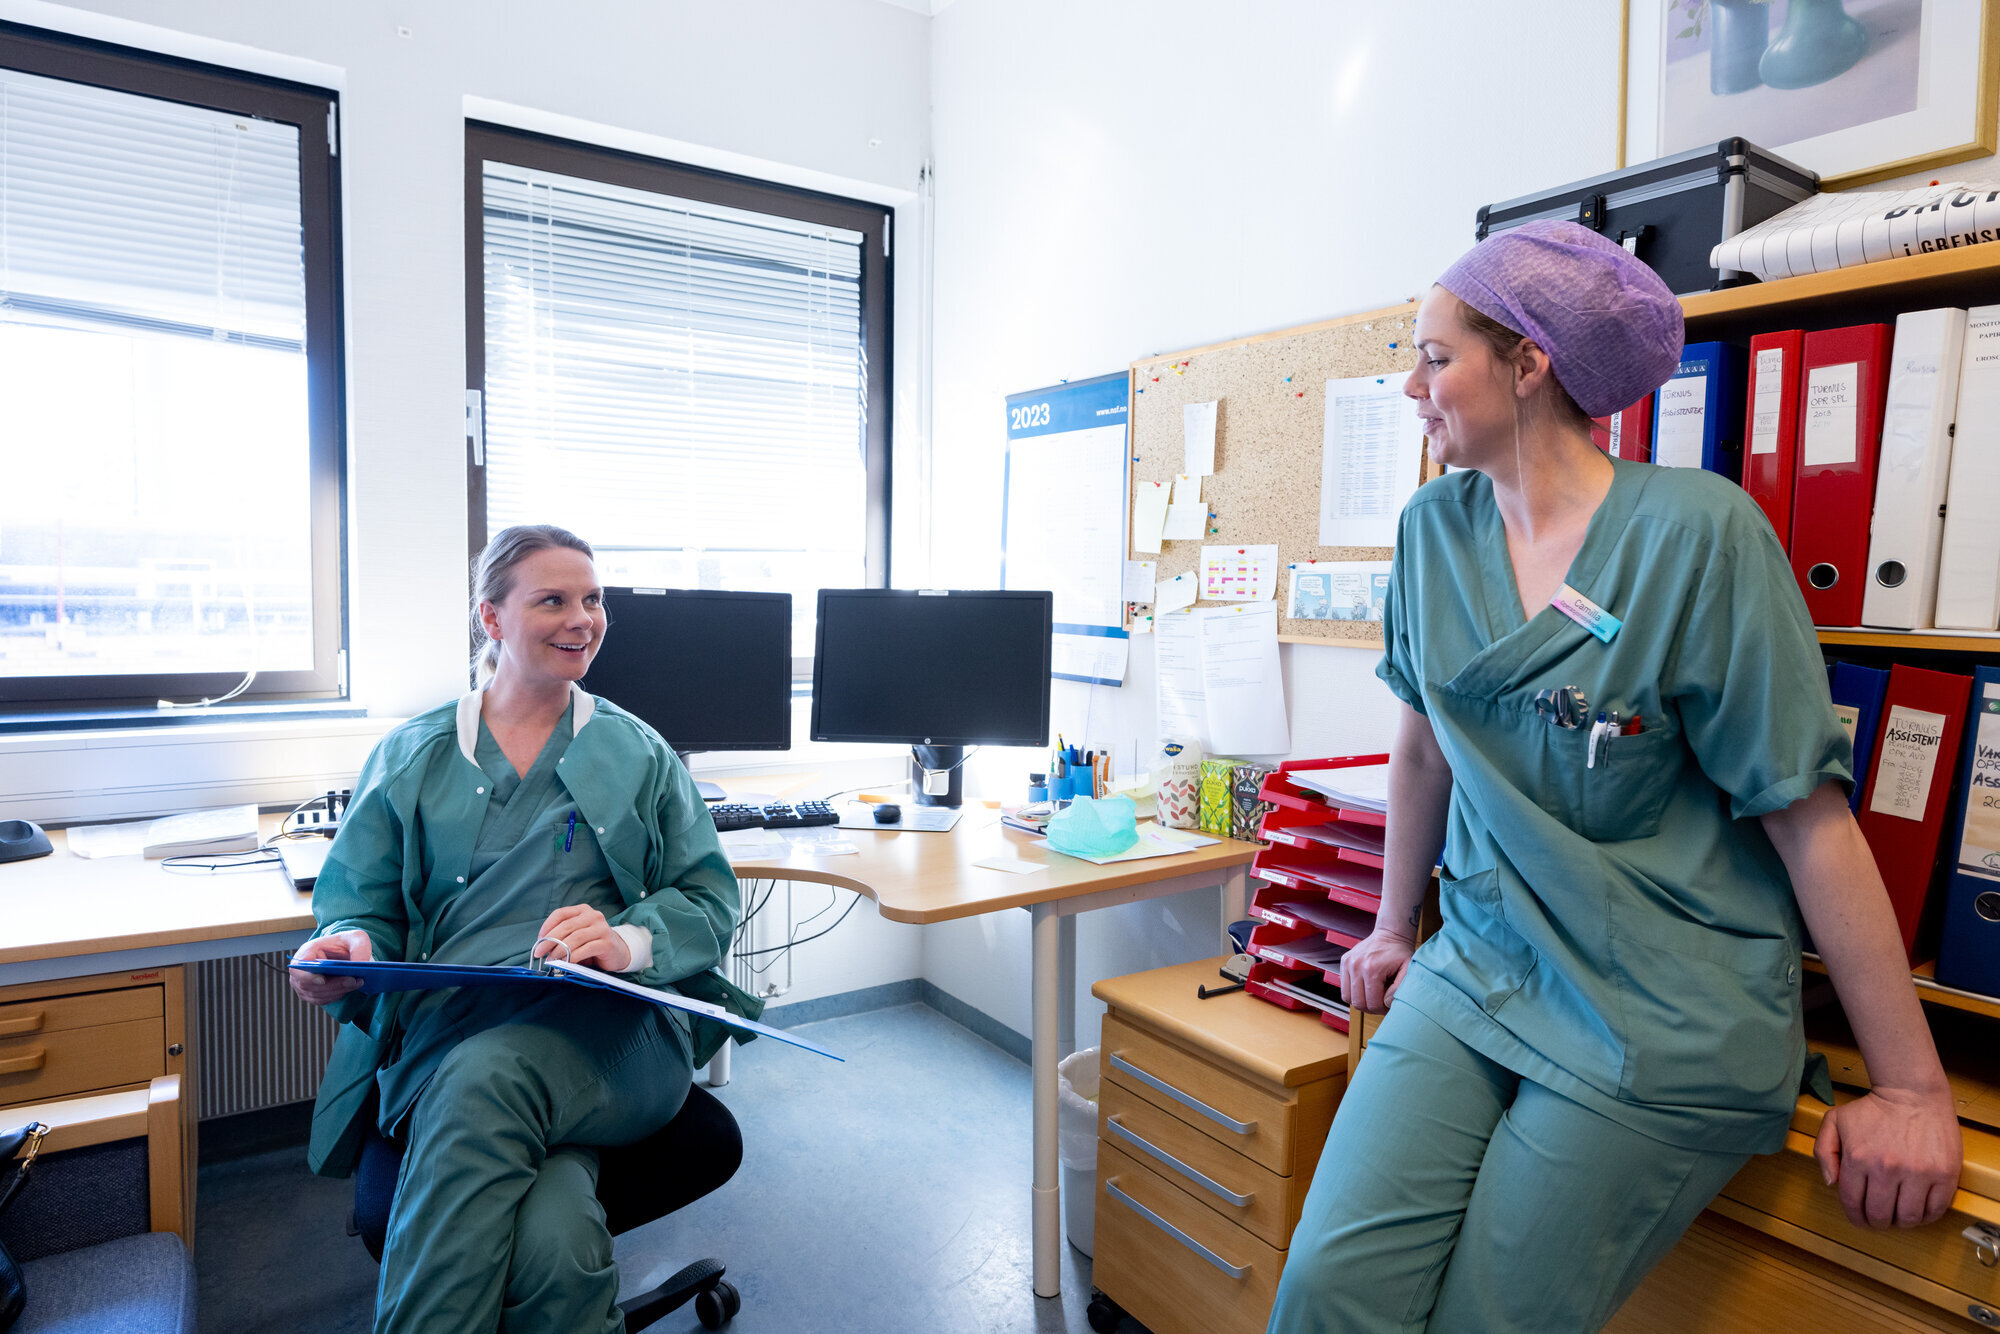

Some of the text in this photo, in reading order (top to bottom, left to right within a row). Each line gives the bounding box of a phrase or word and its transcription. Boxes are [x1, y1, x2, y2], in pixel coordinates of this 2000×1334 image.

[1811, 382, 1846, 394] TURNUS
[1011, 403, 1050, 430] 2023
[1574, 599, 1601, 622] Camilla
[1239, 785, 1256, 794] pukka
